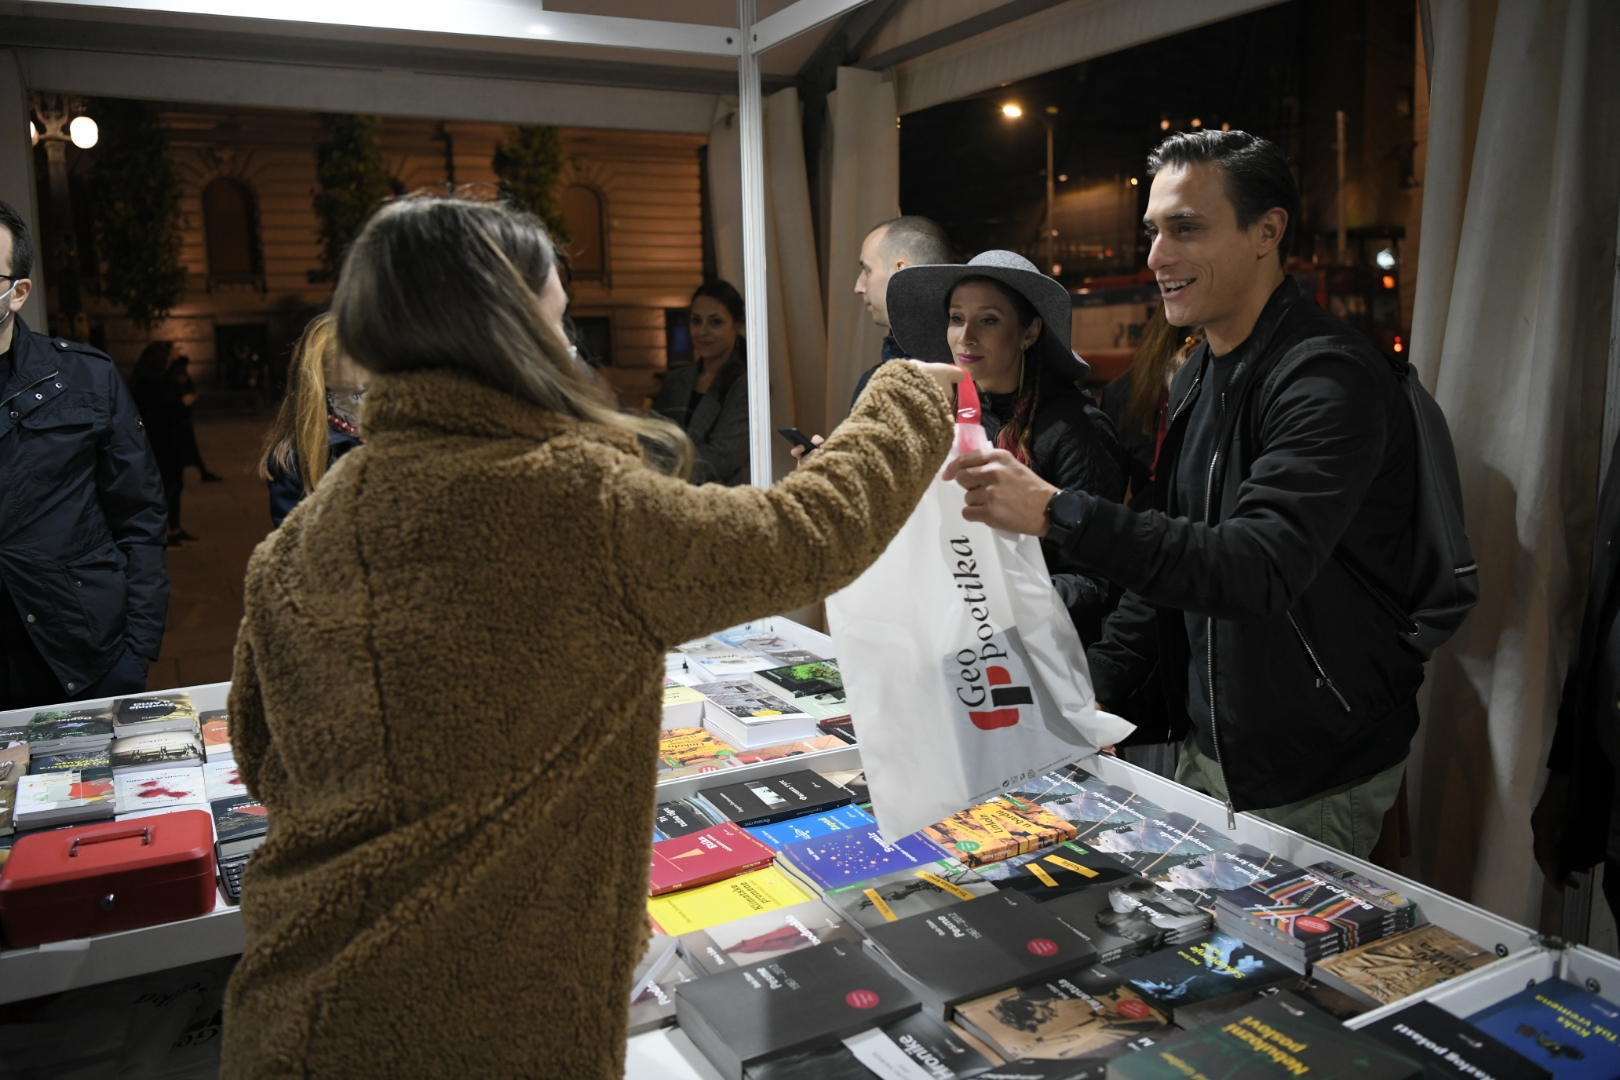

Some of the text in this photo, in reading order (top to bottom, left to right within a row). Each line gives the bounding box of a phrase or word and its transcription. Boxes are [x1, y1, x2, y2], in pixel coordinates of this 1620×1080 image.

[950, 535, 1009, 663] poetika
[956, 649, 986, 708] Geo
[995, 808, 1025, 825] bardu
[698, 835, 719, 850] Etika
[1232, 865, 1260, 881] Brada
[1247, 861, 1278, 879] pljena
[730, 883, 764, 912] Klimatske
[740, 881, 771, 905] promene
[1342, 891, 1375, 912] Braća
[1138, 901, 1166, 921] Mali
[785, 914, 822, 946] oodmaklo
[938, 915, 966, 938] Pesme
[1189, 945, 1246, 979] Sakupljanje
[1200, 942, 1225, 957] vune
[1420, 942, 1475, 972] znutra
[1416, 951, 1456, 976] Onaj
[757, 967, 783, 990] Pesme
[647, 980, 671, 1006] Poodm
[1058, 978, 1105, 1012] Tarantula
[1535, 994, 1619, 1043] Tok vremena
[171, 1028, 219, 1049] Ge
[1238, 1015, 1308, 1055] poslovi
[1392, 1022, 1450, 1057] pošasti
[899, 1033, 956, 1080] Hronike
[1221, 1022, 1311, 1076] Nebulozni
